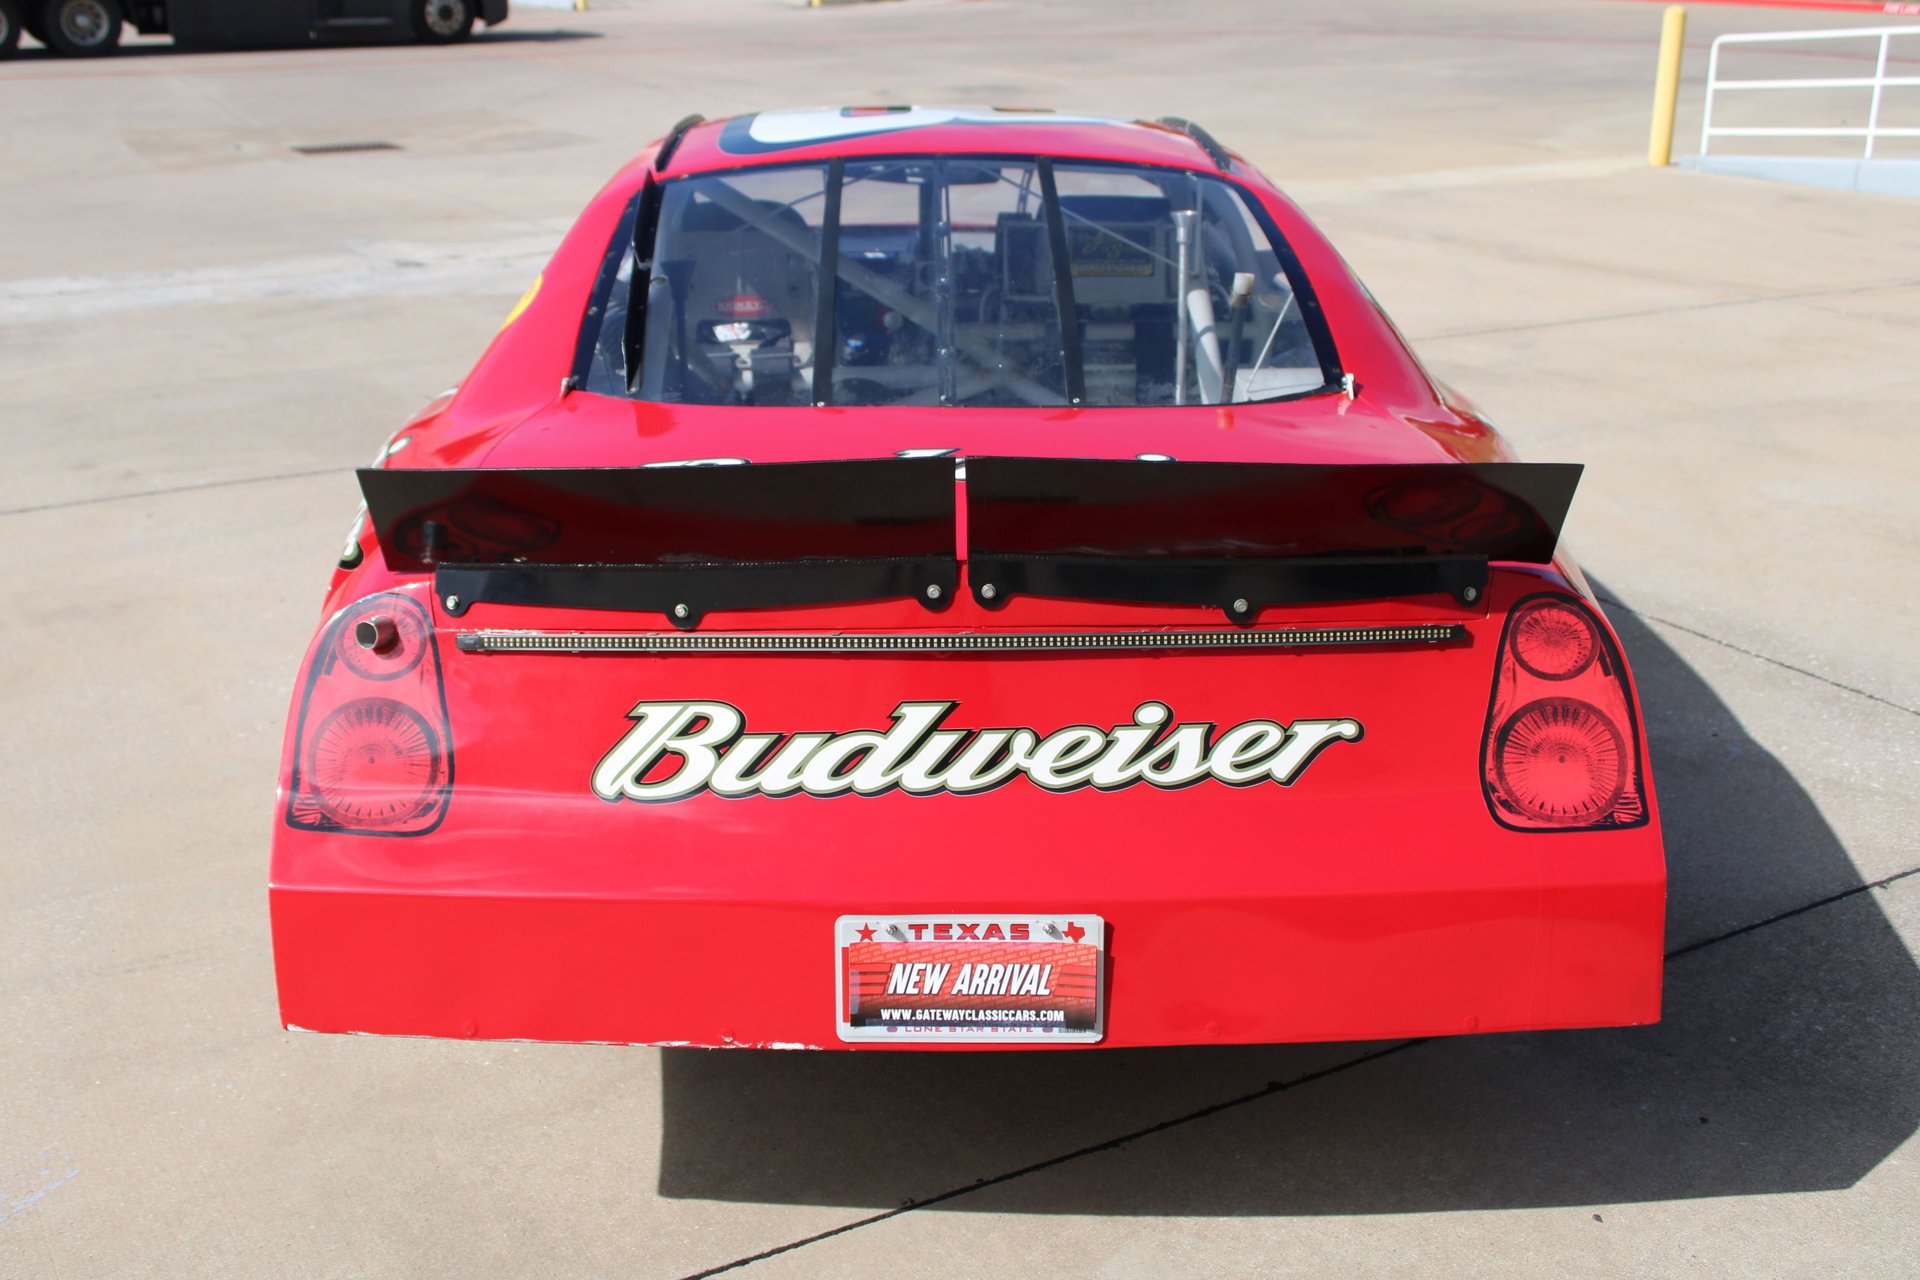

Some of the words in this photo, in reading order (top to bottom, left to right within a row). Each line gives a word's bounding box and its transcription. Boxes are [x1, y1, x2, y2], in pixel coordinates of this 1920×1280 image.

[591, 699, 1364, 804] Budweiser
[908, 923, 1030, 941] TEXAS
[887, 963, 951, 995] NEW
[951, 963, 1052, 996] ARRIVAL
[880, 1008, 1065, 1022] WWW.GATEWAYCLASSICCARS.COM
